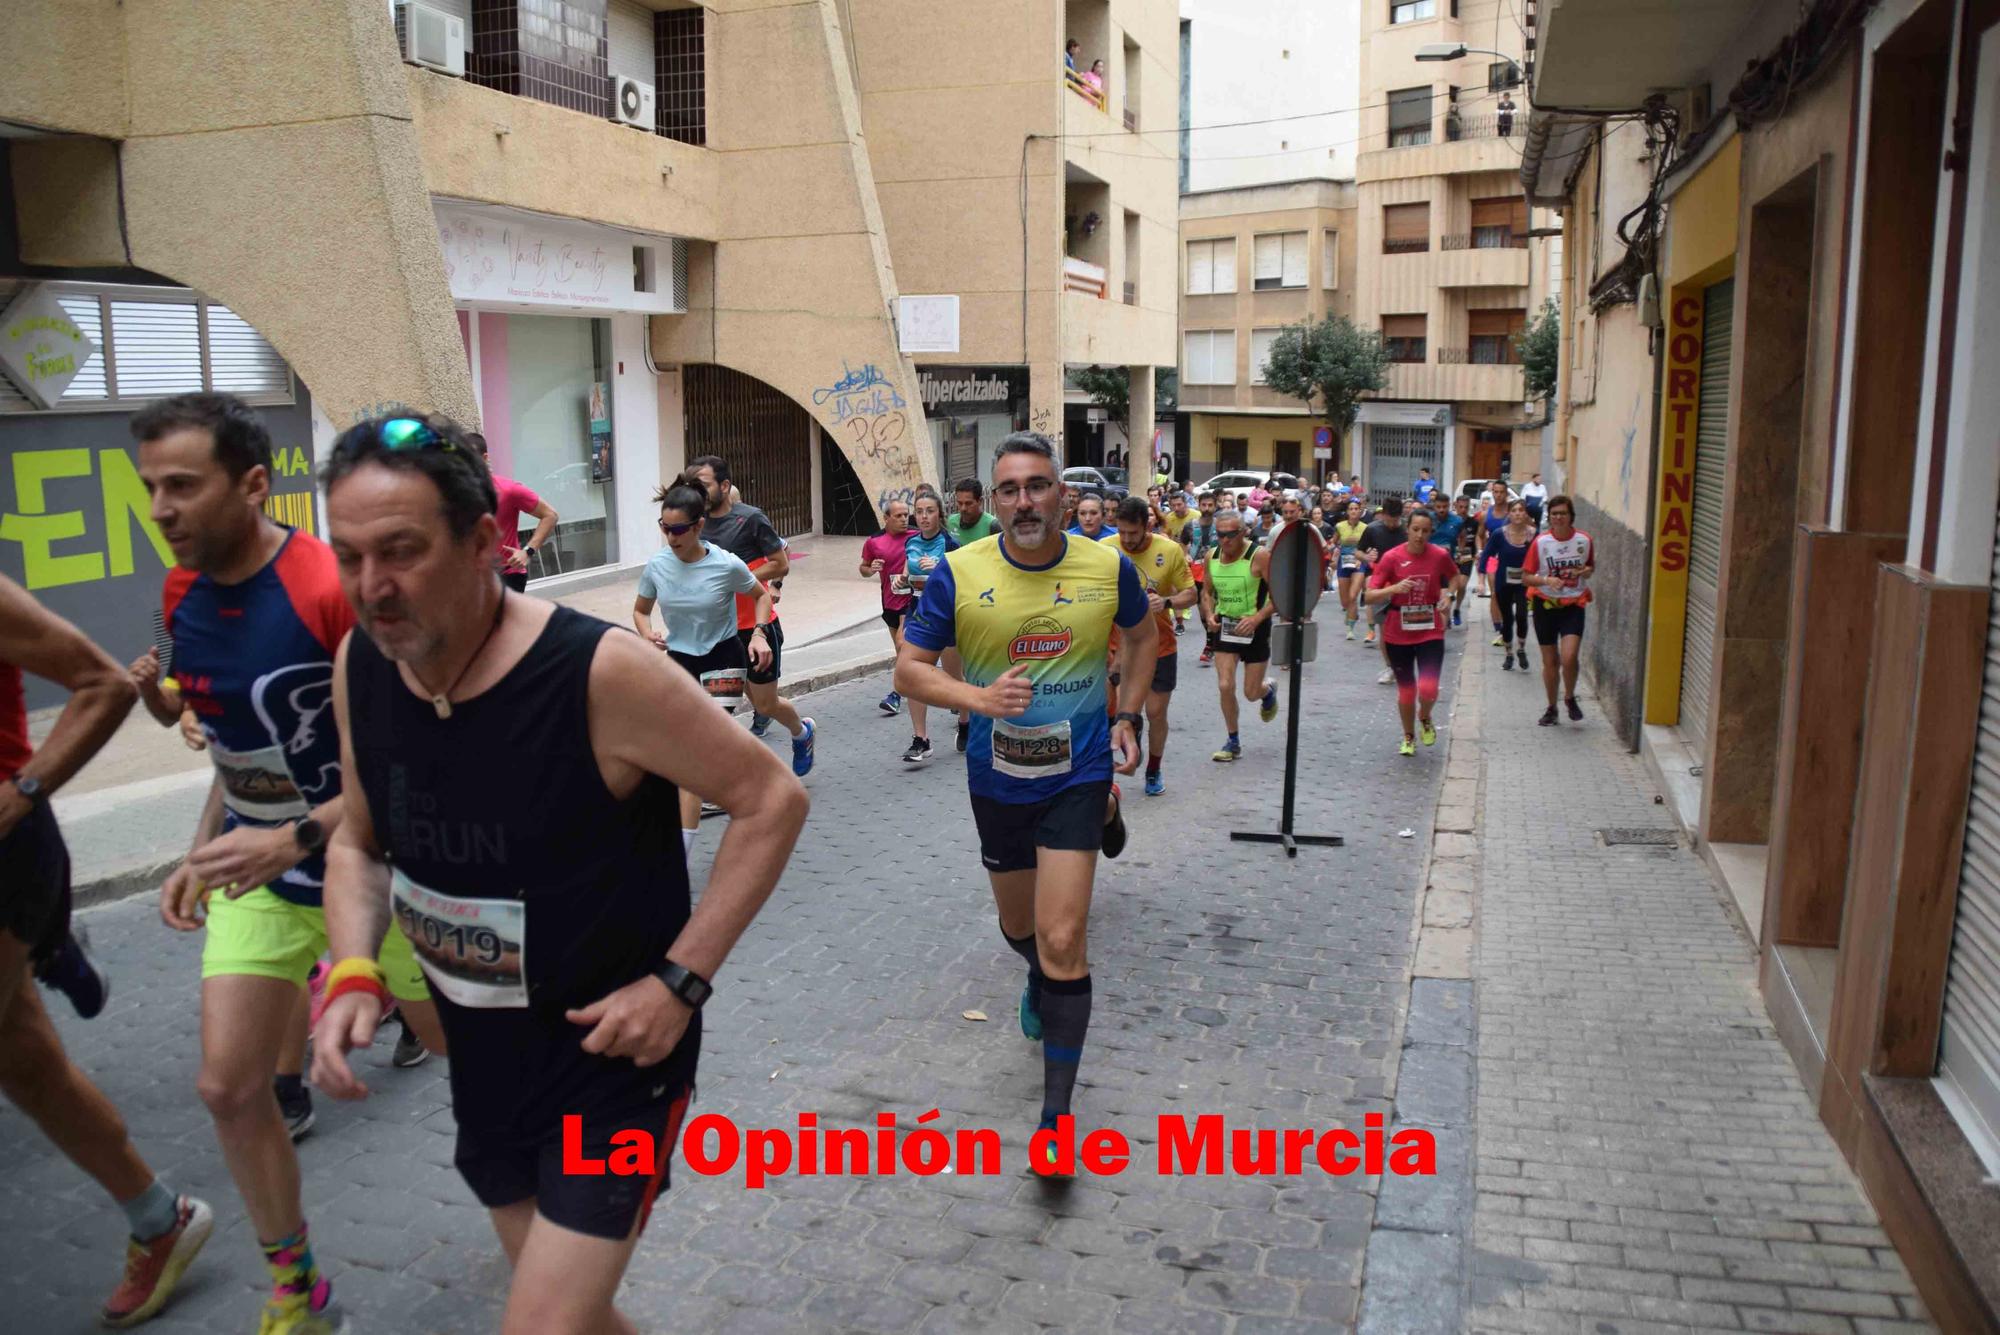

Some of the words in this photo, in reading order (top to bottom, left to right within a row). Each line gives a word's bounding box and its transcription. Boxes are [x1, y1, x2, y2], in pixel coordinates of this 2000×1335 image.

[918, 370, 1010, 411] Hipercalzados
[1660, 296, 1701, 572] CORTINAS
[1015, 640, 1028, 653] El
[1030, 639, 1066, 653] Llano
[1043, 677, 1094, 696] BRUJAS
[1002, 736, 1060, 756] 1128
[410, 818, 509, 865] RUN
[402, 905, 502, 964] 1019
